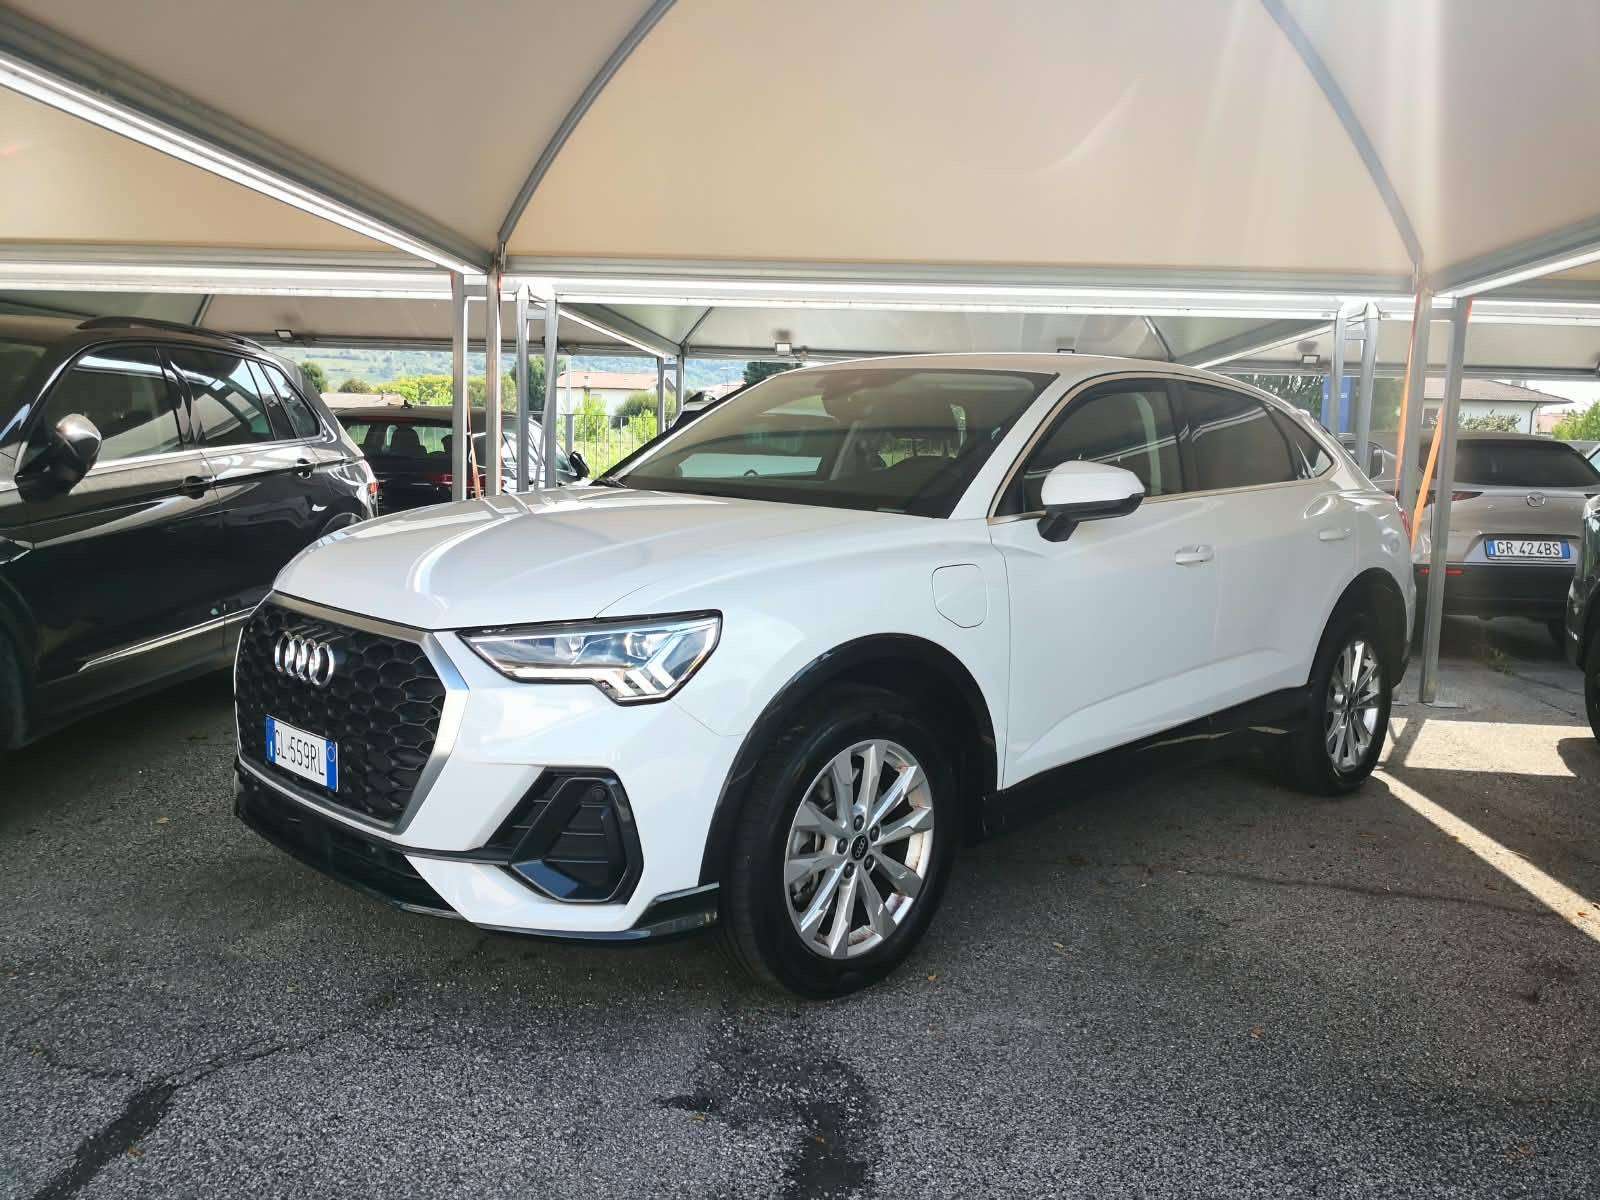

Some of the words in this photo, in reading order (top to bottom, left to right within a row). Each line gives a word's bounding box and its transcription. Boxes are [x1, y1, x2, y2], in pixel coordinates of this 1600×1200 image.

[1497, 541, 1513, 555] GR
[1519, 542, 1561, 556] 424BS
[290, 736, 325, 776] 559RL
